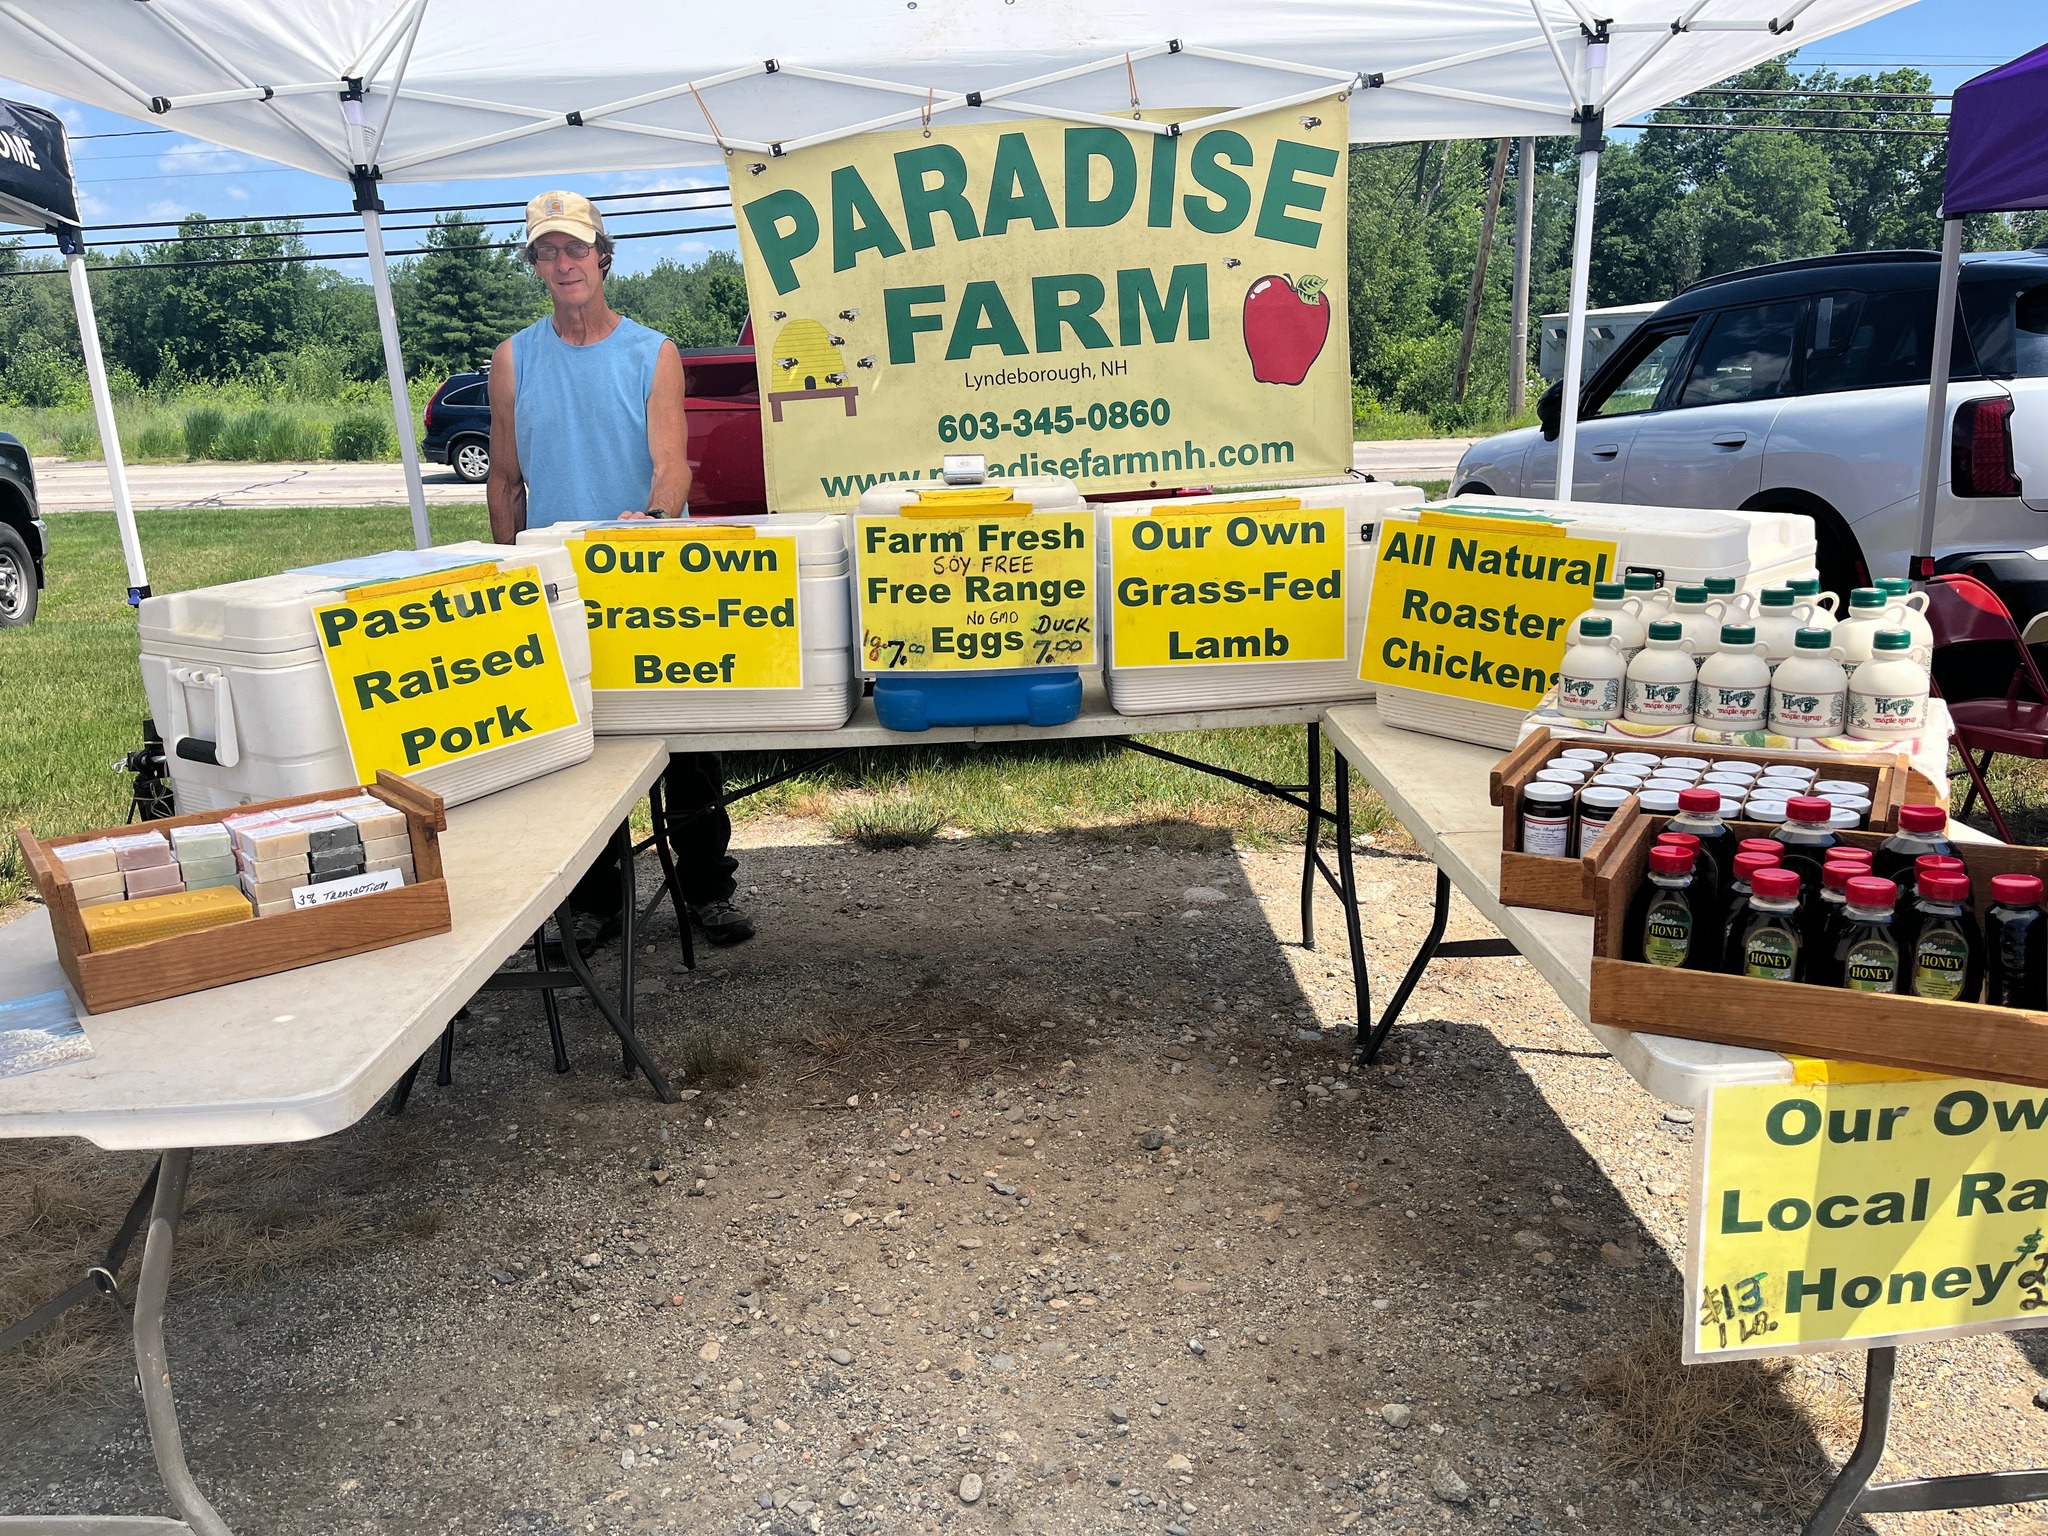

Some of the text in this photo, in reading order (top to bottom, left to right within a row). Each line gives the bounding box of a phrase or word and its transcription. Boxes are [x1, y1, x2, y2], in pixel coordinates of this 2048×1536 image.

[742, 127, 1339, 296] PARADISE
[884, 263, 1210, 365] FARM
[964, 360, 1127, 389] Lyndeborough, NH
[938, 398, 1171, 443] 603-345-0860
[866, 522, 1085, 554] Farm Fresh
[1132, 516, 1326, 550] Our Own
[585, 542, 778, 574] Our Own
[933, 555, 1034, 576] SOY FREE
[1383, 531, 1608, 587] All Natural
[868, 576, 1086, 607] Free Range
[1117, 569, 1341, 608] Grass-Fed
[319, 581, 540, 648] Pasture
[584, 597, 795, 630] Grass-Fed
[989, 611, 1019, 625] GMO
[1030, 614, 1091, 635] DUCK
[1401, 588, 1567, 642] Roaster
[931, 626, 1024, 660] Eggs
[1168, 627, 1290, 660] Lamb
[353, 633, 545, 711] Raised
[634, 654, 736, 684] Beef
[401, 704, 533, 766] Pork
[171, 893, 219, 905] WAX
[298, 893, 316, 905] 3%
[1651, 925, 1686, 938] HONEY
[1751, 952, 1790, 967] HONEY
[1852, 967, 1891, 980] HONEY
[1921, 955, 1961, 969] HONEY
[1765, 1098, 1910, 1146] Our
[1721, 1178, 1930, 1235] Local
[1785, 1261, 2018, 1314] Honey
[1719, 1322, 1728, 1349] 1
